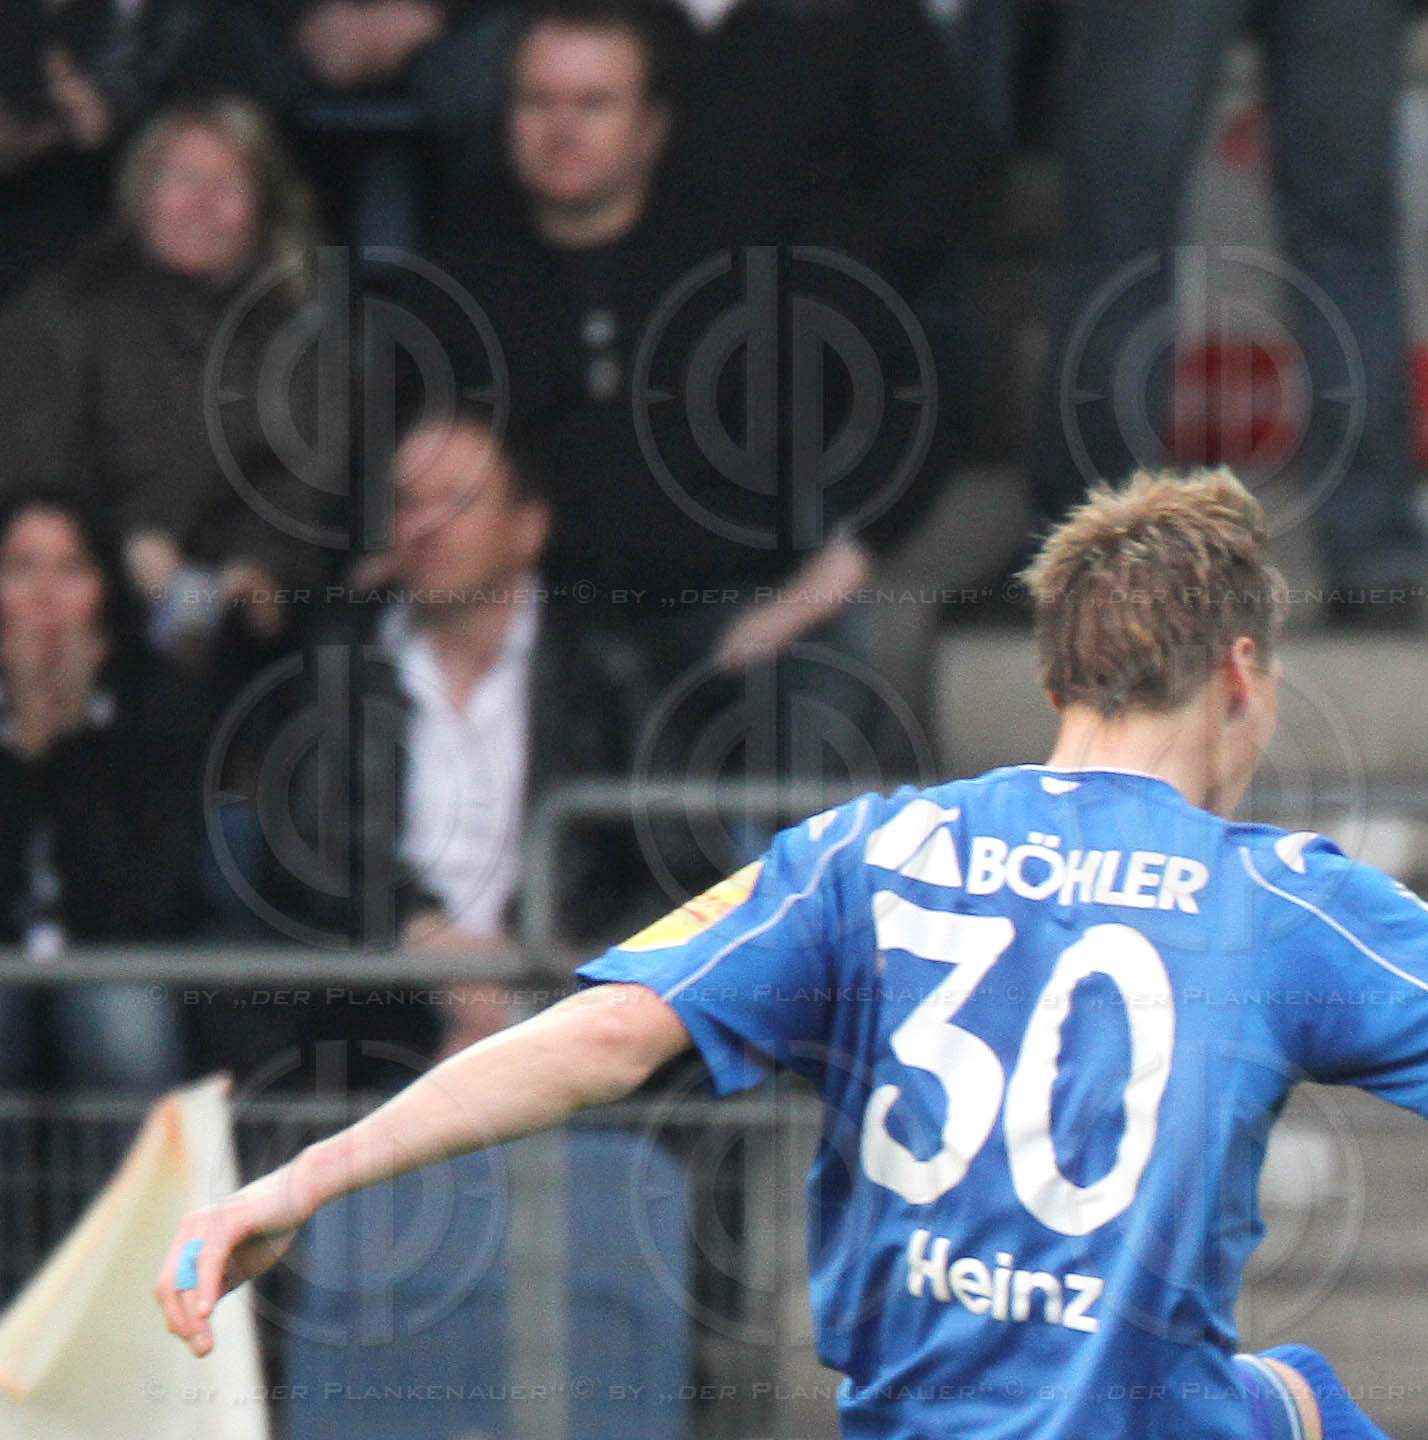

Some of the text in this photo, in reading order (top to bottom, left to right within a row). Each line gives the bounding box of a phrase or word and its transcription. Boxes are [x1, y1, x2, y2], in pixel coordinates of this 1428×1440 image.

[967, 832, 1209, 914] BÖHLER
[861, 889, 1177, 1237] 30
[907, 1229, 1103, 1332] Heinz
